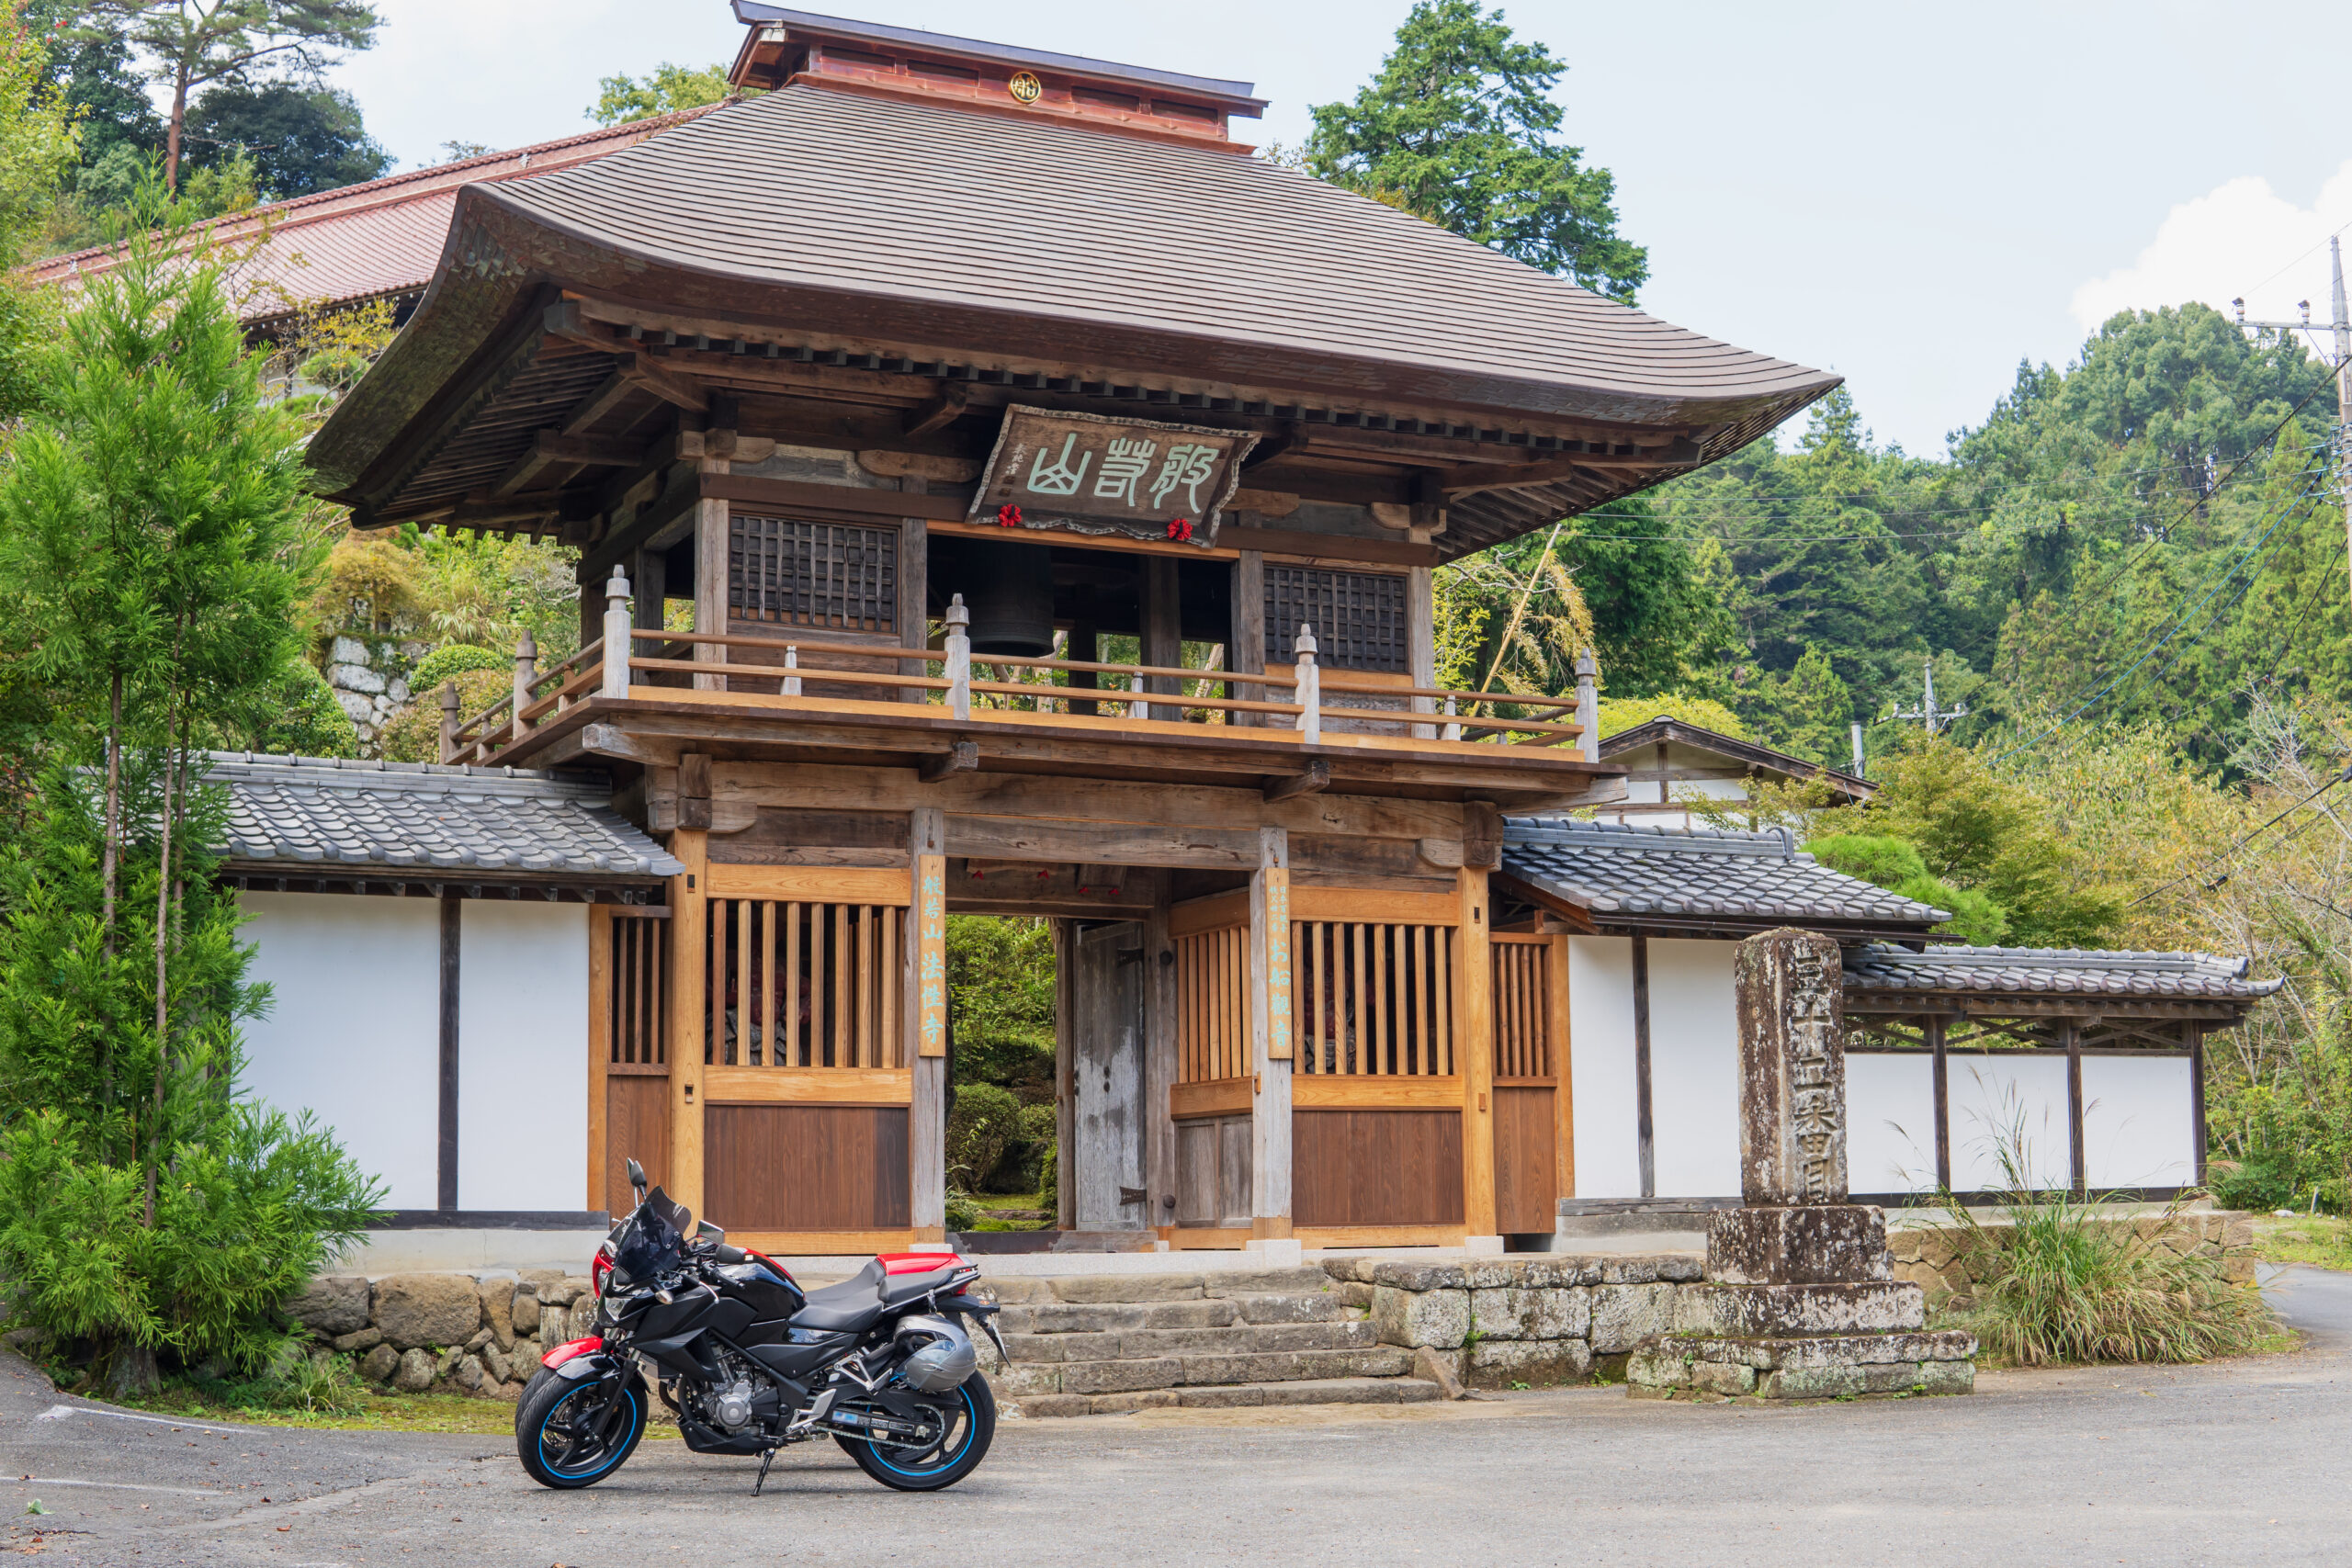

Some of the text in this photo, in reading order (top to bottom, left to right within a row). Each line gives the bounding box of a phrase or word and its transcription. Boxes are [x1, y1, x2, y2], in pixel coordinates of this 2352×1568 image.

[921, 874, 944, 1044] 般若山 法性寺
[1791, 954, 1838, 1197] 三十二番目
